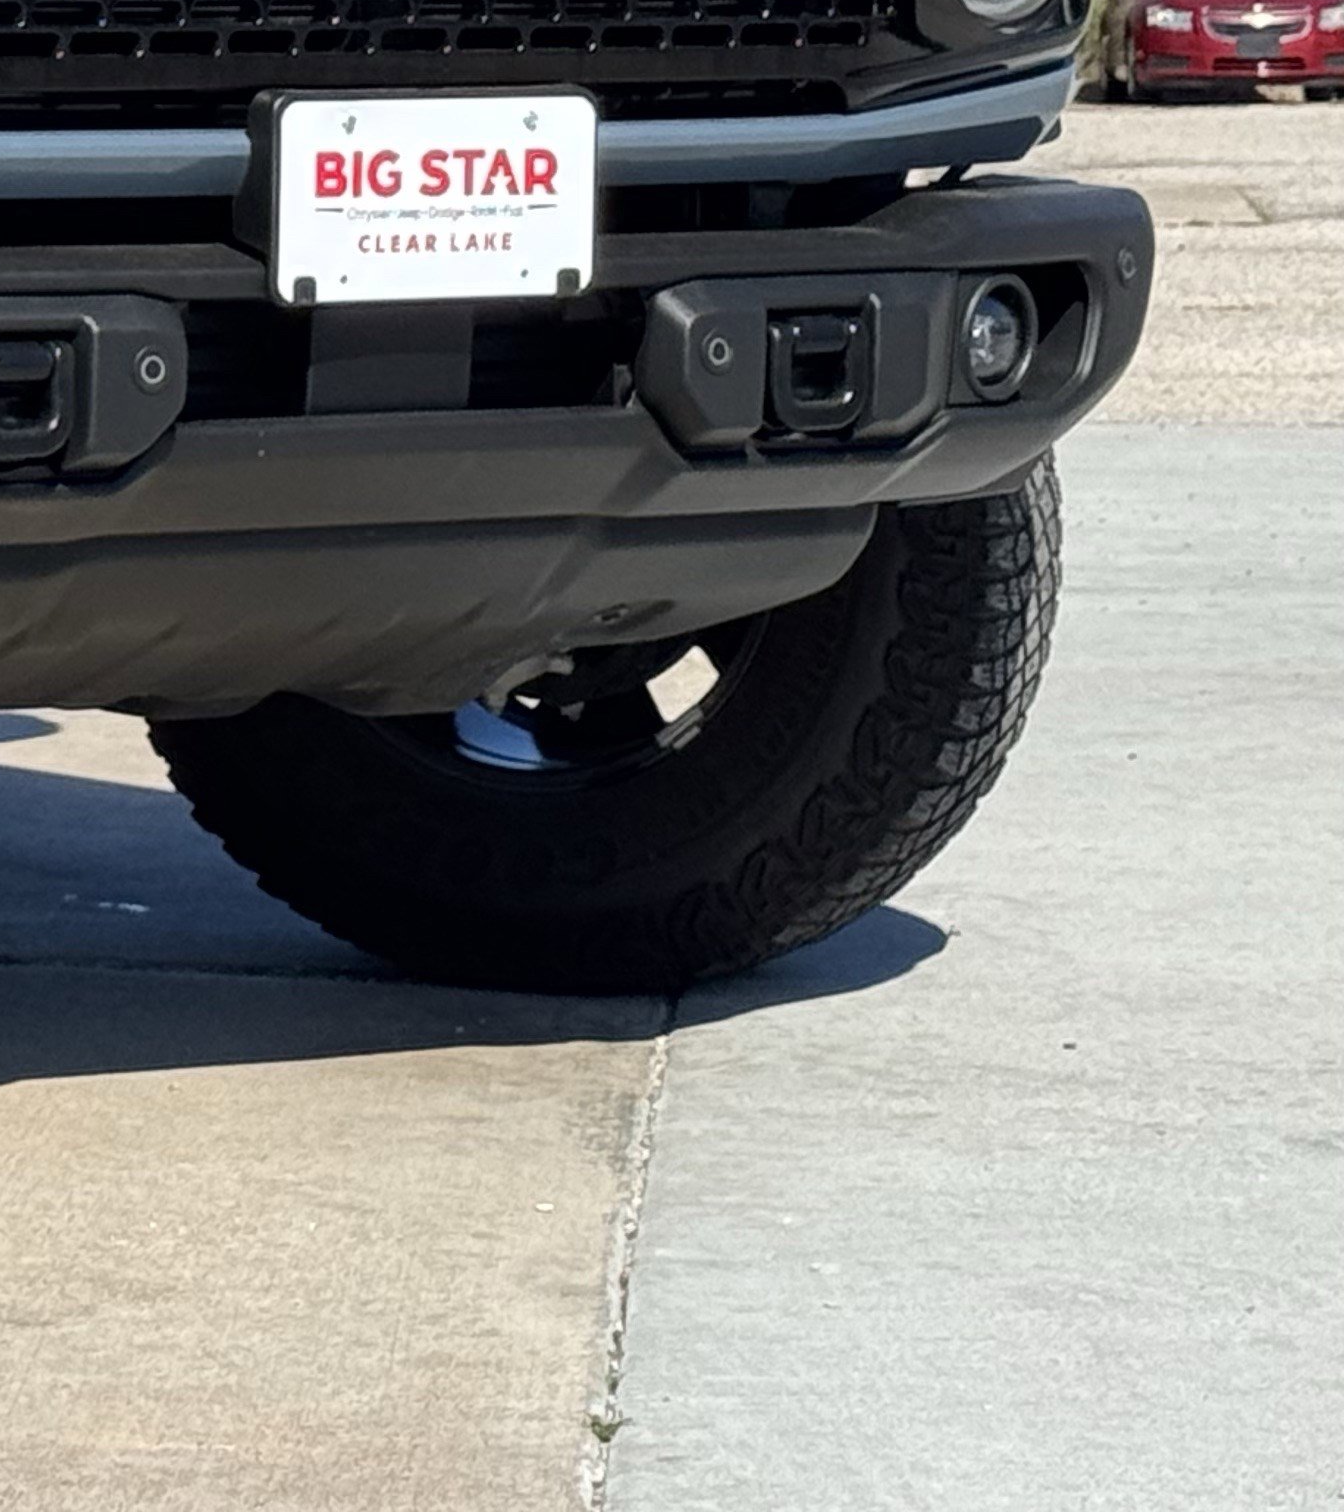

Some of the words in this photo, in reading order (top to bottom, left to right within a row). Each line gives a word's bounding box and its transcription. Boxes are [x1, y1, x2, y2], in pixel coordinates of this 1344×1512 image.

[314, 148, 403, 199] BIG
[418, 147, 559, 198] STAR
[357, 233, 438, 255] CLEAR
[449, 231, 514, 253] LAKE
